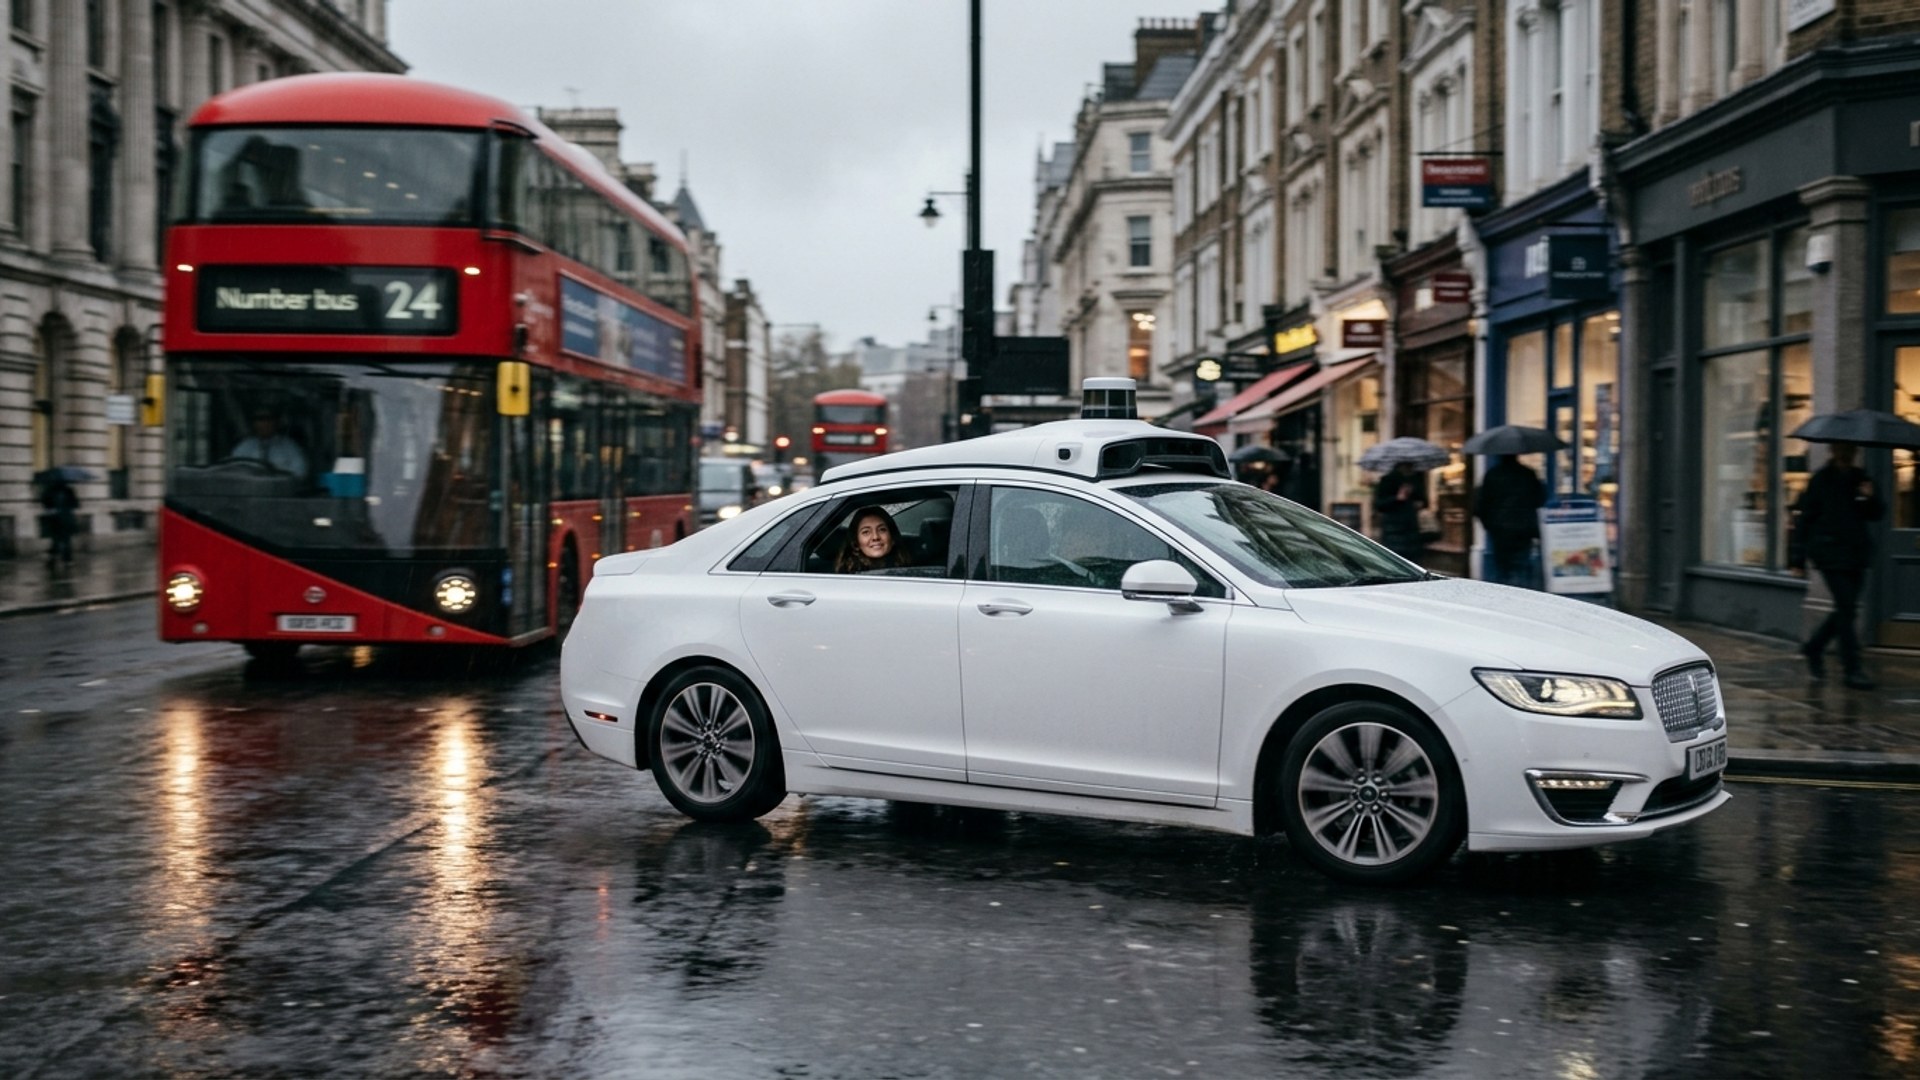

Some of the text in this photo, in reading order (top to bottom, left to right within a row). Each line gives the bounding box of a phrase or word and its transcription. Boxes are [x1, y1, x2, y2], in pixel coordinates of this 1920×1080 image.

[216, 281, 443, 319] Number bus 24
